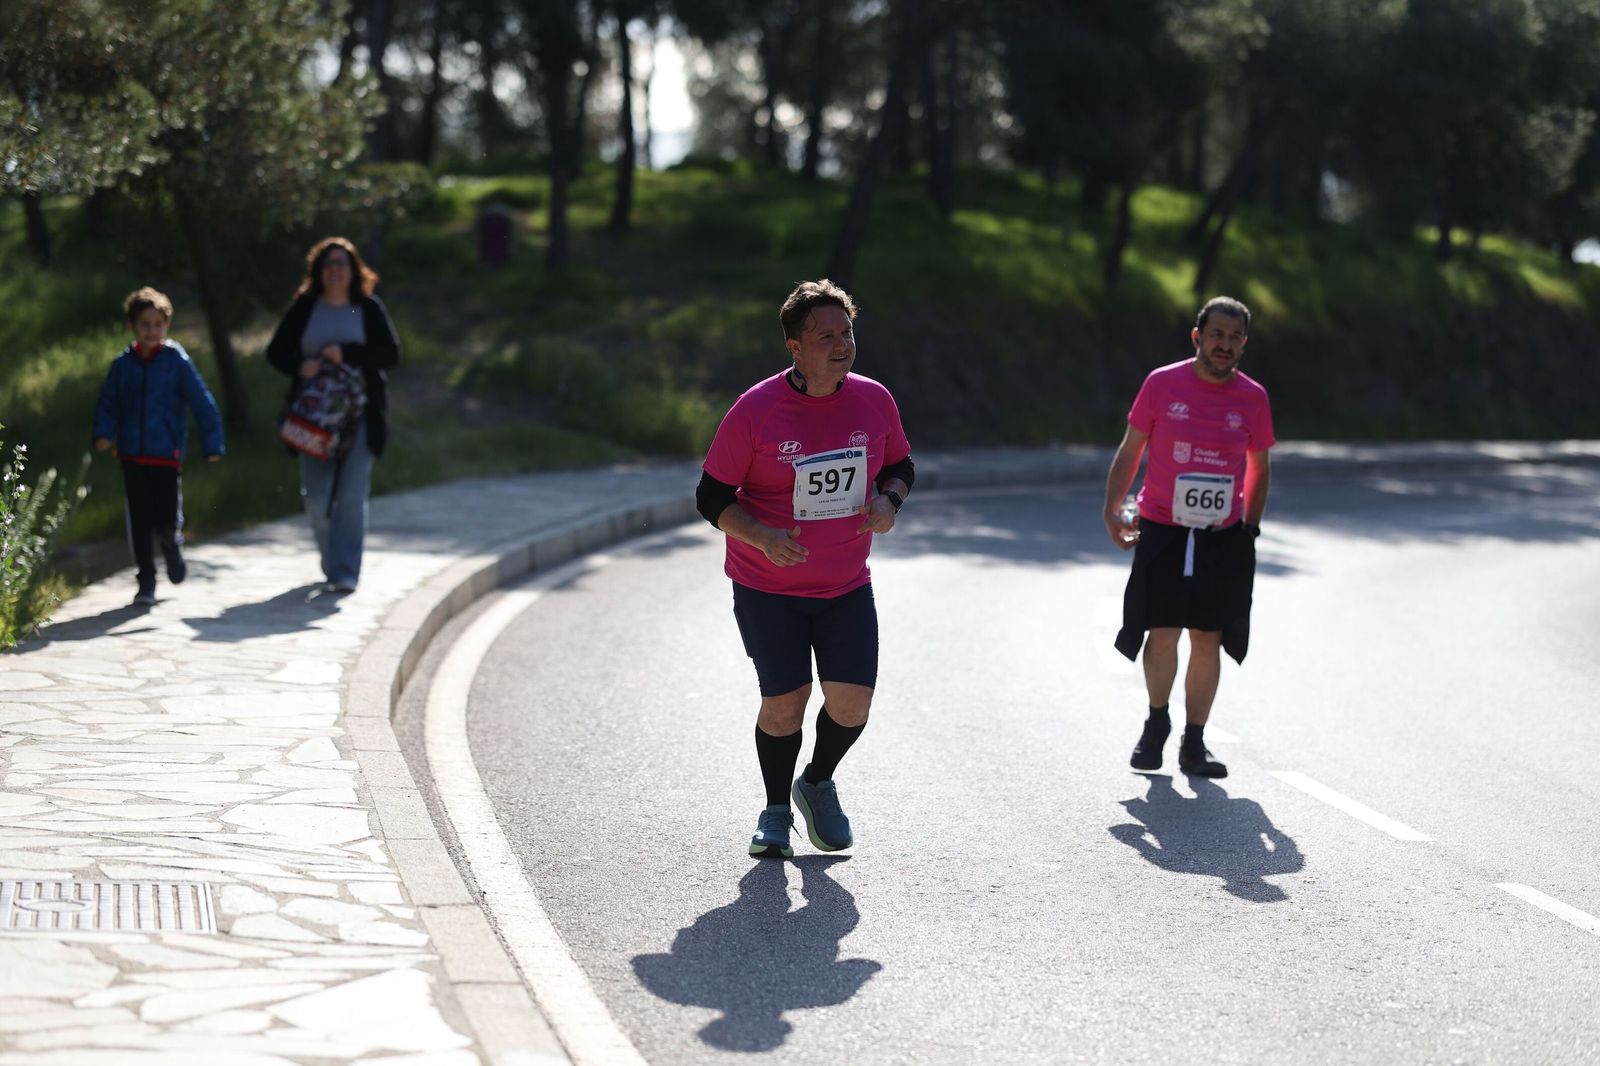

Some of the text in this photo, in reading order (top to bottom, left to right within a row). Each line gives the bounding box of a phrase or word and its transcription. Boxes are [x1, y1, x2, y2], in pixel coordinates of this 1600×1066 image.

[1194, 448, 1220, 458] Ciudad
[808, 466, 856, 496] 597
[1185, 488, 1225, 510] 666
